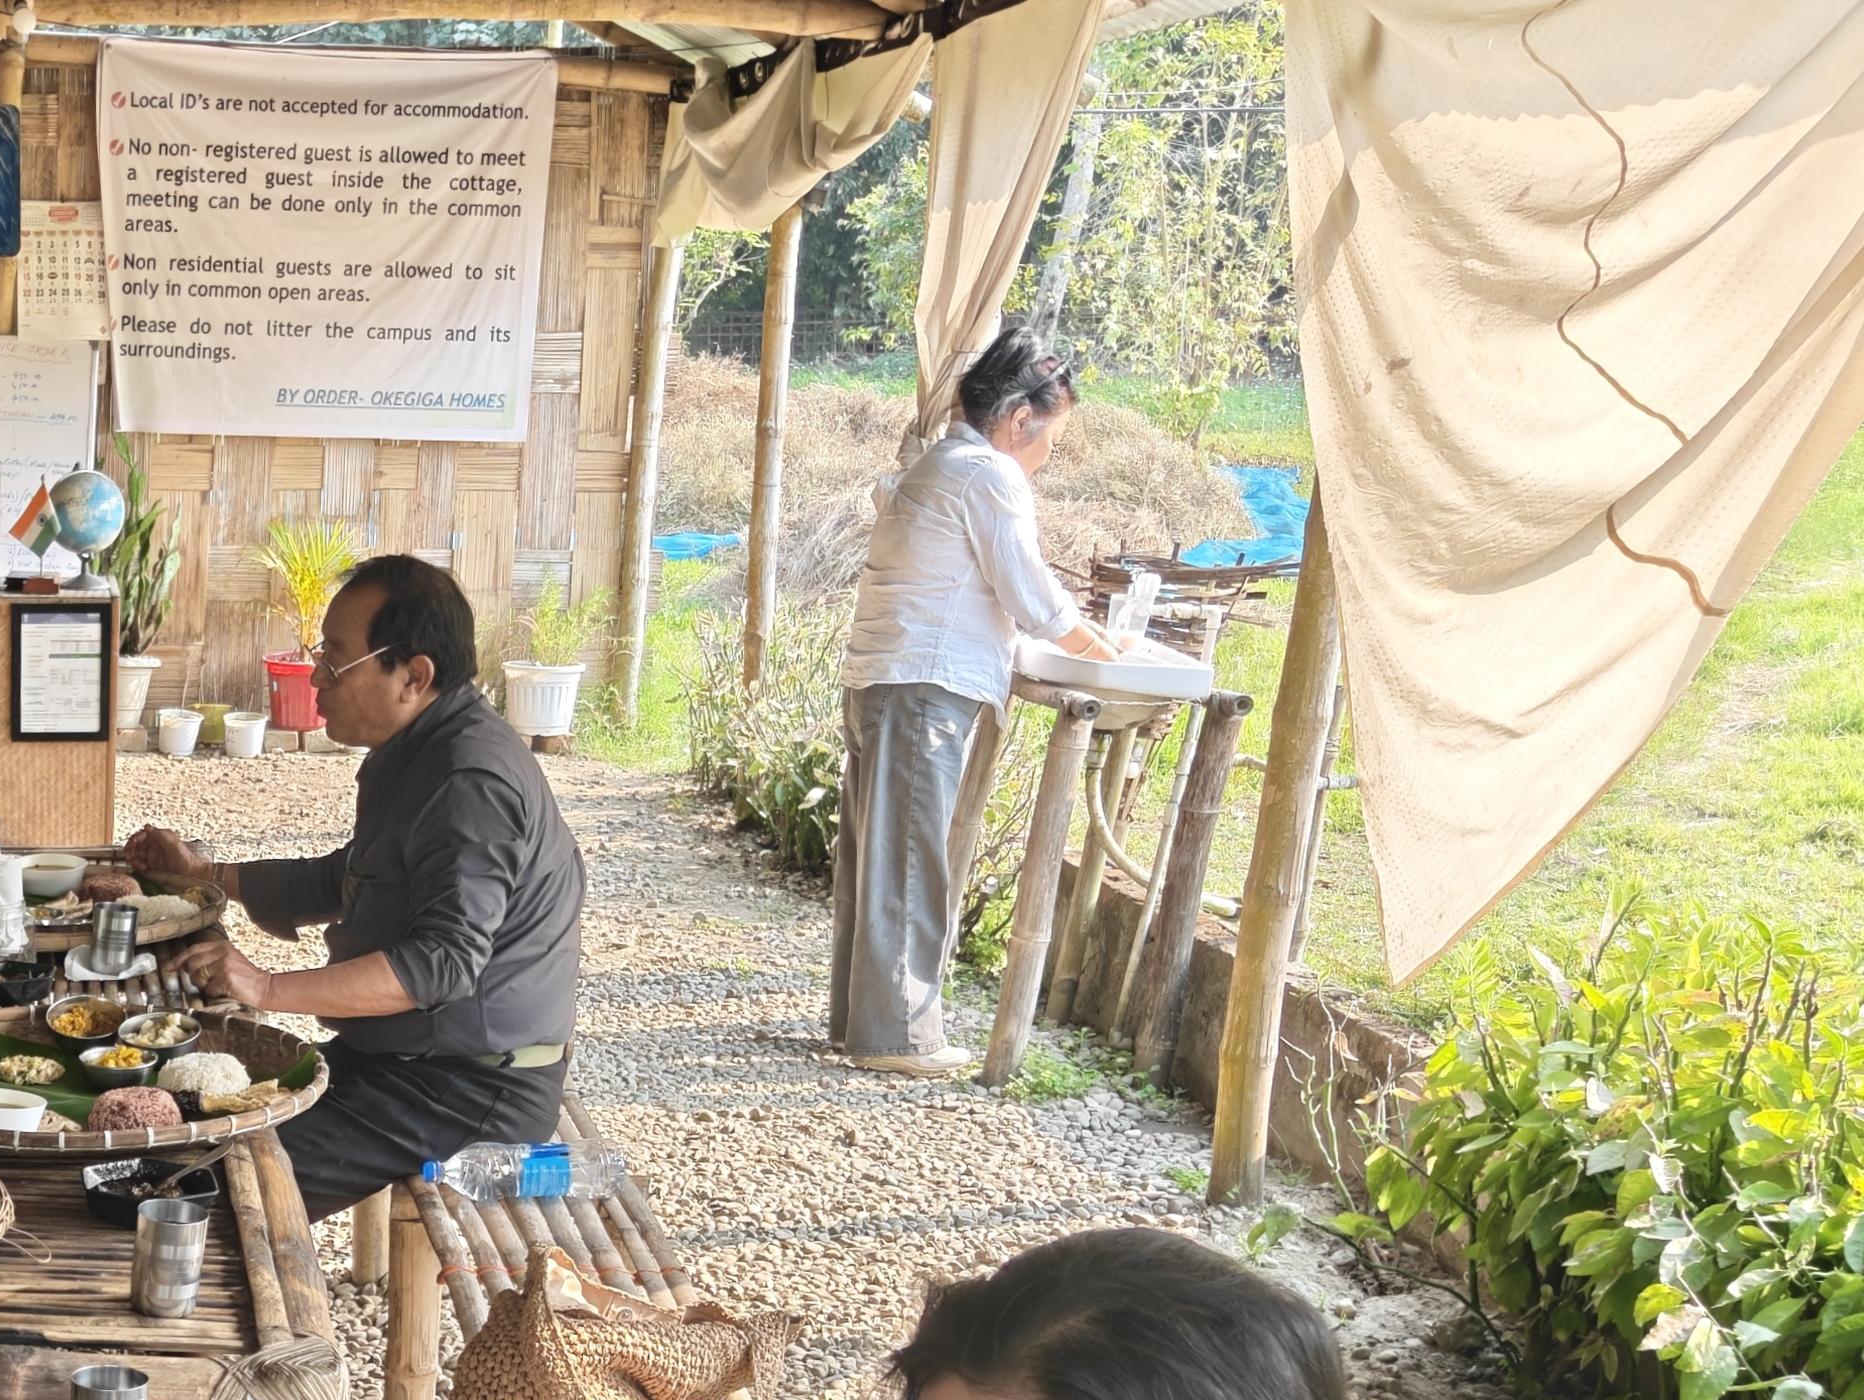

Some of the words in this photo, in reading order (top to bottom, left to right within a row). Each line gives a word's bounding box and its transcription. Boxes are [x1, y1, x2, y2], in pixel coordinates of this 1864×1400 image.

[130, 91, 174, 109] Local
[180, 93, 210, 111] ID's
[215, 98, 243, 111] are
[248, 97, 276, 113] not
[281, 99, 358, 118] accepted
[363, 99, 389, 116] for
[393, 102, 529, 120] accommodation.
[128, 137, 152, 156] No
[158, 142, 198, 157] non-
[205, 141, 297, 163] registered
[303, 146, 352, 165] guest
[359, 145, 373, 163] is
[378, 146, 449, 165] allowed
[456, 149, 474, 166] to
[480, 151, 526, 167] meet
[126, 167, 137, 181] a
[155, 165, 247, 187] registered
[265, 171, 313, 190] guest
[332, 170, 384, 189] inside
[402, 172, 432, 190] the
[449, 175, 522, 196] cottage,
[126, 190, 199, 213] meeting
[208, 195, 240, 210] can
[249, 192, 272, 211] be
[281, 194, 325, 213] done
[334, 196, 373, 218] only
[382, 197, 398, 215] in
[408, 197, 438, 216] the
[447, 202, 521, 218] common
[124, 218, 178, 233] areas.
[123, 253, 157, 271] Non
[169, 255, 264, 274] residential
[275, 260, 332, 279] guests
[343, 263, 373, 278] are
[384, 261, 453, 279] allowed
[465, 264, 483, 280] to
[494, 264, 516, 281] sit
[121, 278, 160, 300] only
[165, 279, 182, 297] in
[187, 283, 262, 299] common
[267, 286, 311, 304] open
[317, 288, 370, 303] areas.
[121, 314, 177, 334] Please
[189, 317, 212, 335] do
[224, 320, 253, 336] not
[266, 319, 313, 338] litter
[325, 321, 354, 339] the
[366, 326, 432, 345] campus
[444, 325, 477, 342] and
[490, 325, 511, 343] its
[119, 342, 236, 364] surroundings.
[276, 387, 300, 403] BY
[303, 388, 364, 405] ORDER-
[371, 390, 444, 407] OKEGIGA
[448, 392, 506, 409] HOMES
